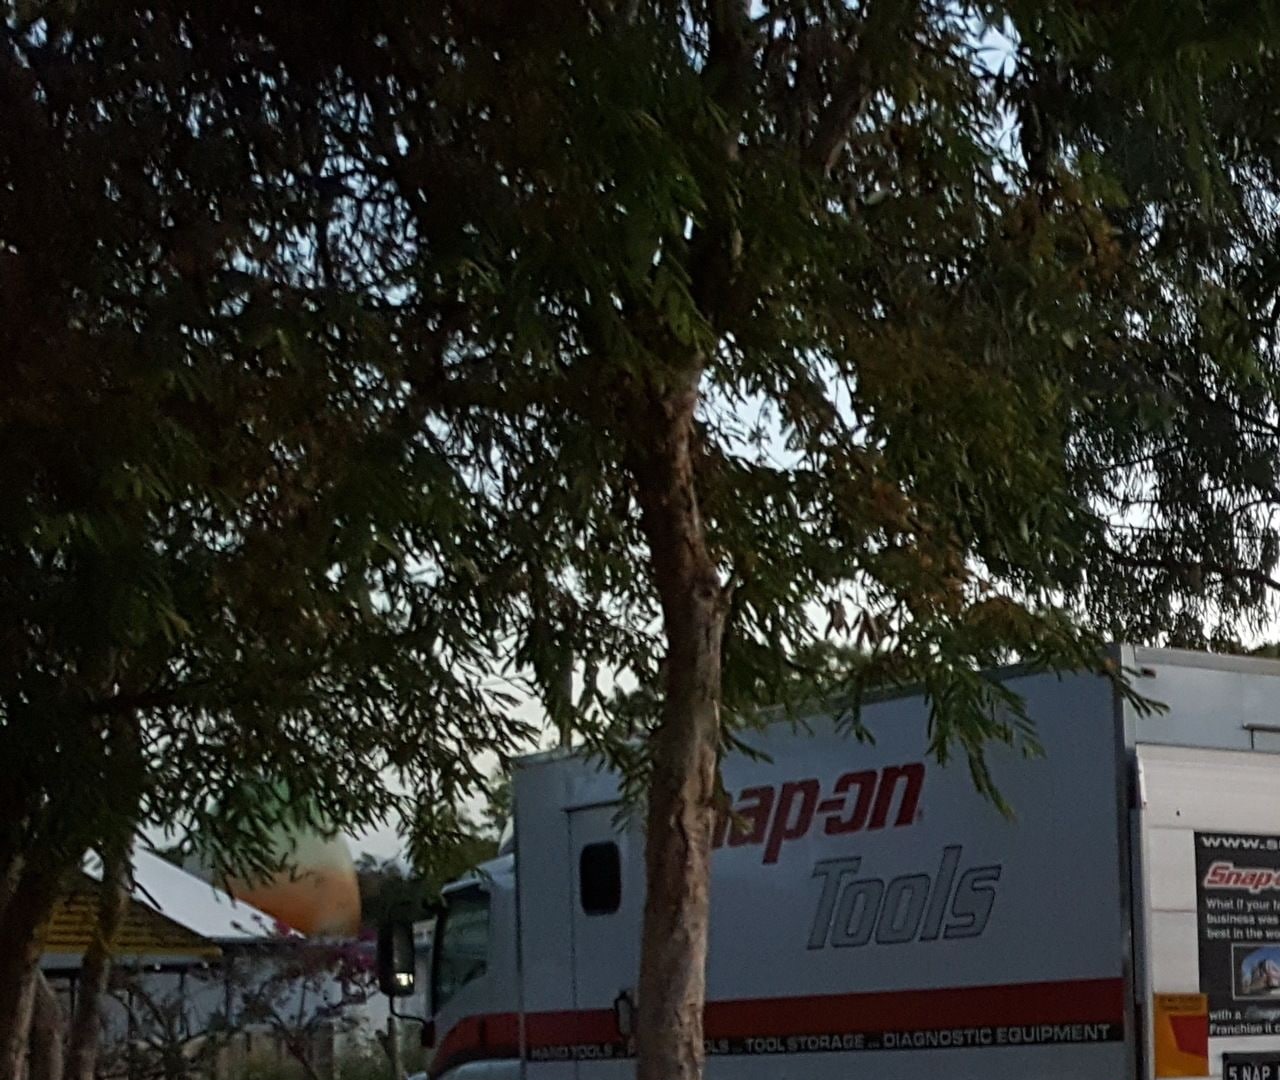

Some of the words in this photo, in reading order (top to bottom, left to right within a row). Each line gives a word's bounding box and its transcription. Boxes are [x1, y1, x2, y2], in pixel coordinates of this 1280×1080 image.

[807, 845, 1002, 951] Tools
[1206, 898, 1233, 910] What
[1236, 898, 1244, 911] if
[1246, 901, 1270, 913] your
[1206, 913, 1255, 925] business
[1257, 915, 1279, 925] was
[1207, 928, 1230, 939] best
[1233, 927, 1244, 939] in
[1245, 927, 1263, 939] the
[1209, 1009, 1232, 1021] with
[1234, 1011, 1242, 1020] a
[1209, 1021, 1263, 1035] Franchise
[745, 1036, 785, 1052] TOOL
[787, 1032, 865, 1051] STORAGE
[882, 1027, 993, 1048] DIAGNOSTIC
[995, 1023, 1110, 1044] EQUIPMENT
